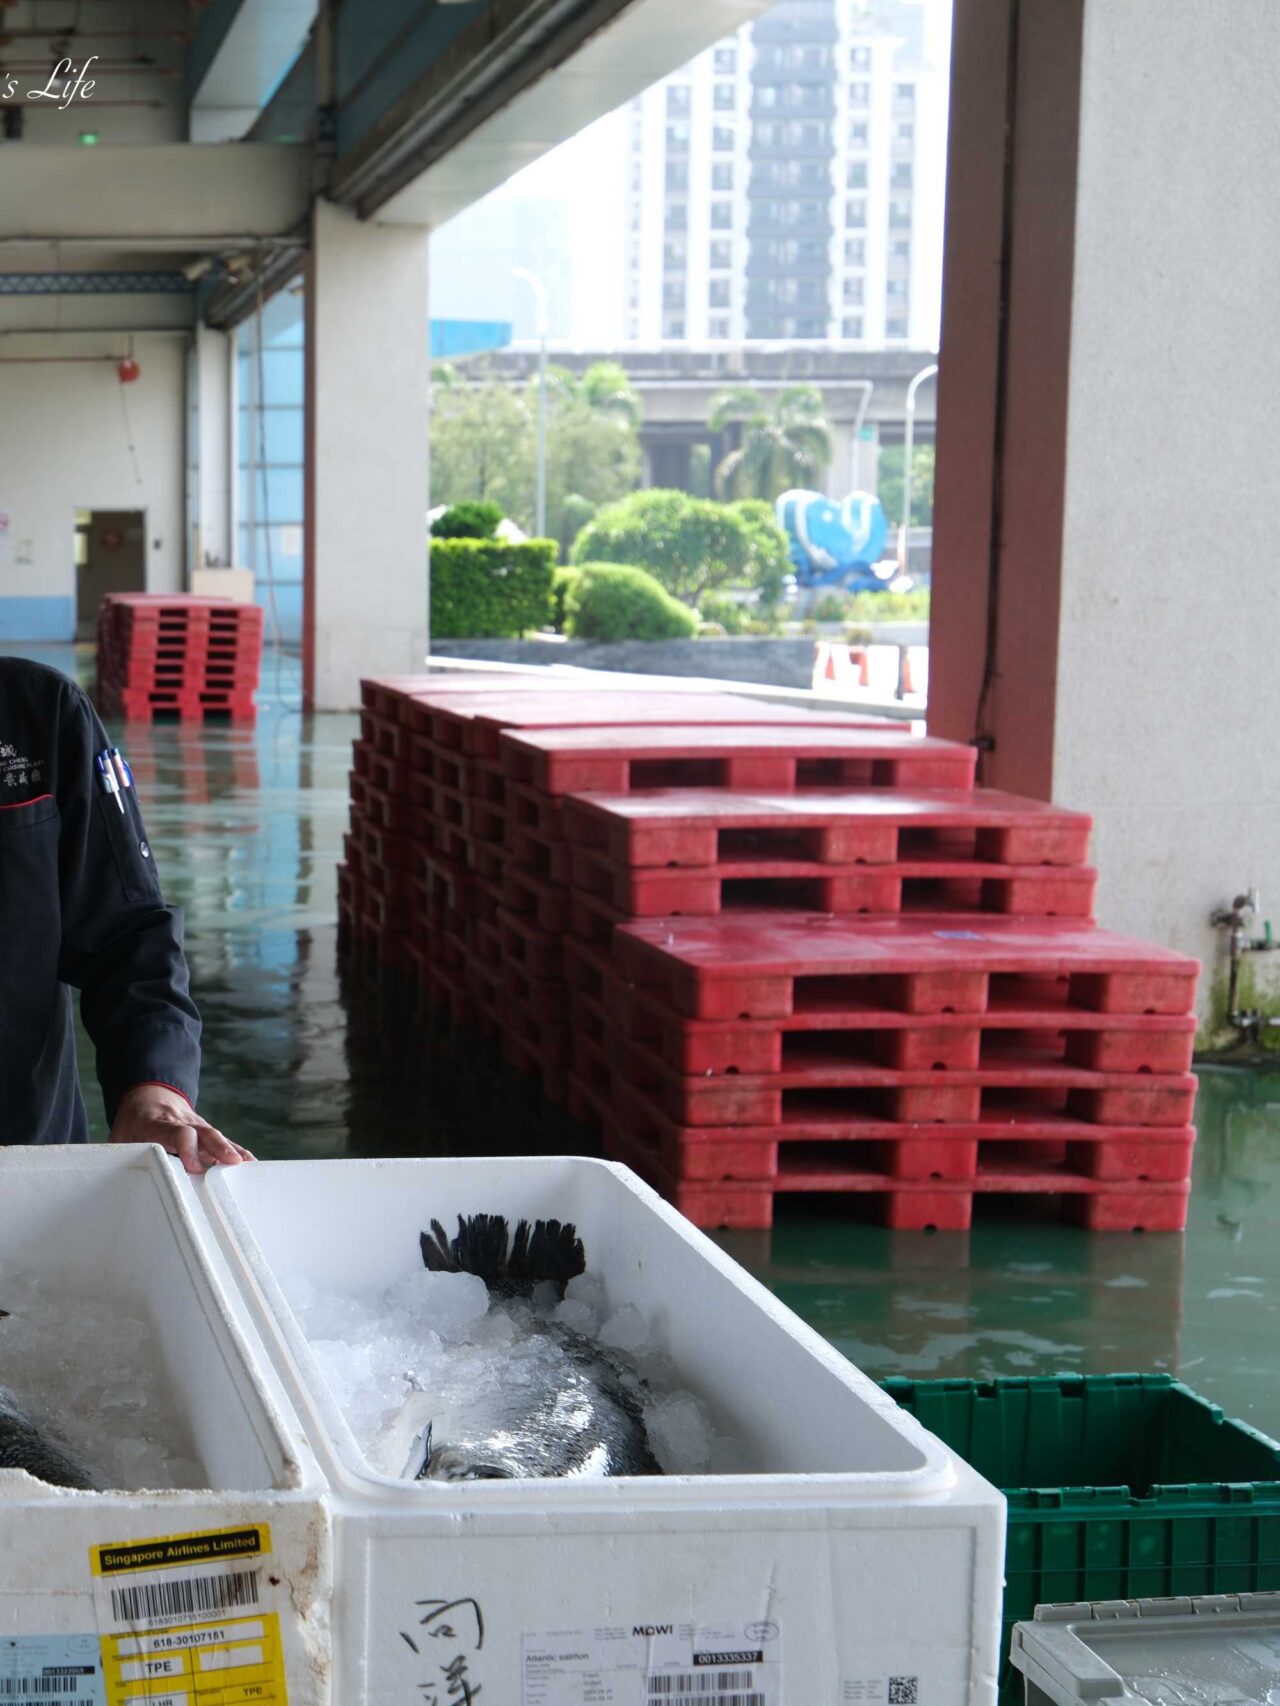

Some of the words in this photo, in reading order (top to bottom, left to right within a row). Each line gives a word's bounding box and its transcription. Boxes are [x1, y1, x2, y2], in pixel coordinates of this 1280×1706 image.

[104, 1549, 163, 1566] Singapore
[166, 1543, 210, 1557] Airlines
[213, 1536, 256, 1550] Limited
[632, 1624, 674, 1637] MOWI
[153, 1630, 226, 1648] 618-30107151
[526, 1654, 556, 1663] Atlantic
[558, 1653, 590, 1661] salmon
[698, 1651, 758, 1665] 0013335337
[145, 1660, 173, 1674] TPE
[242, 1686, 263, 1697] TPE
